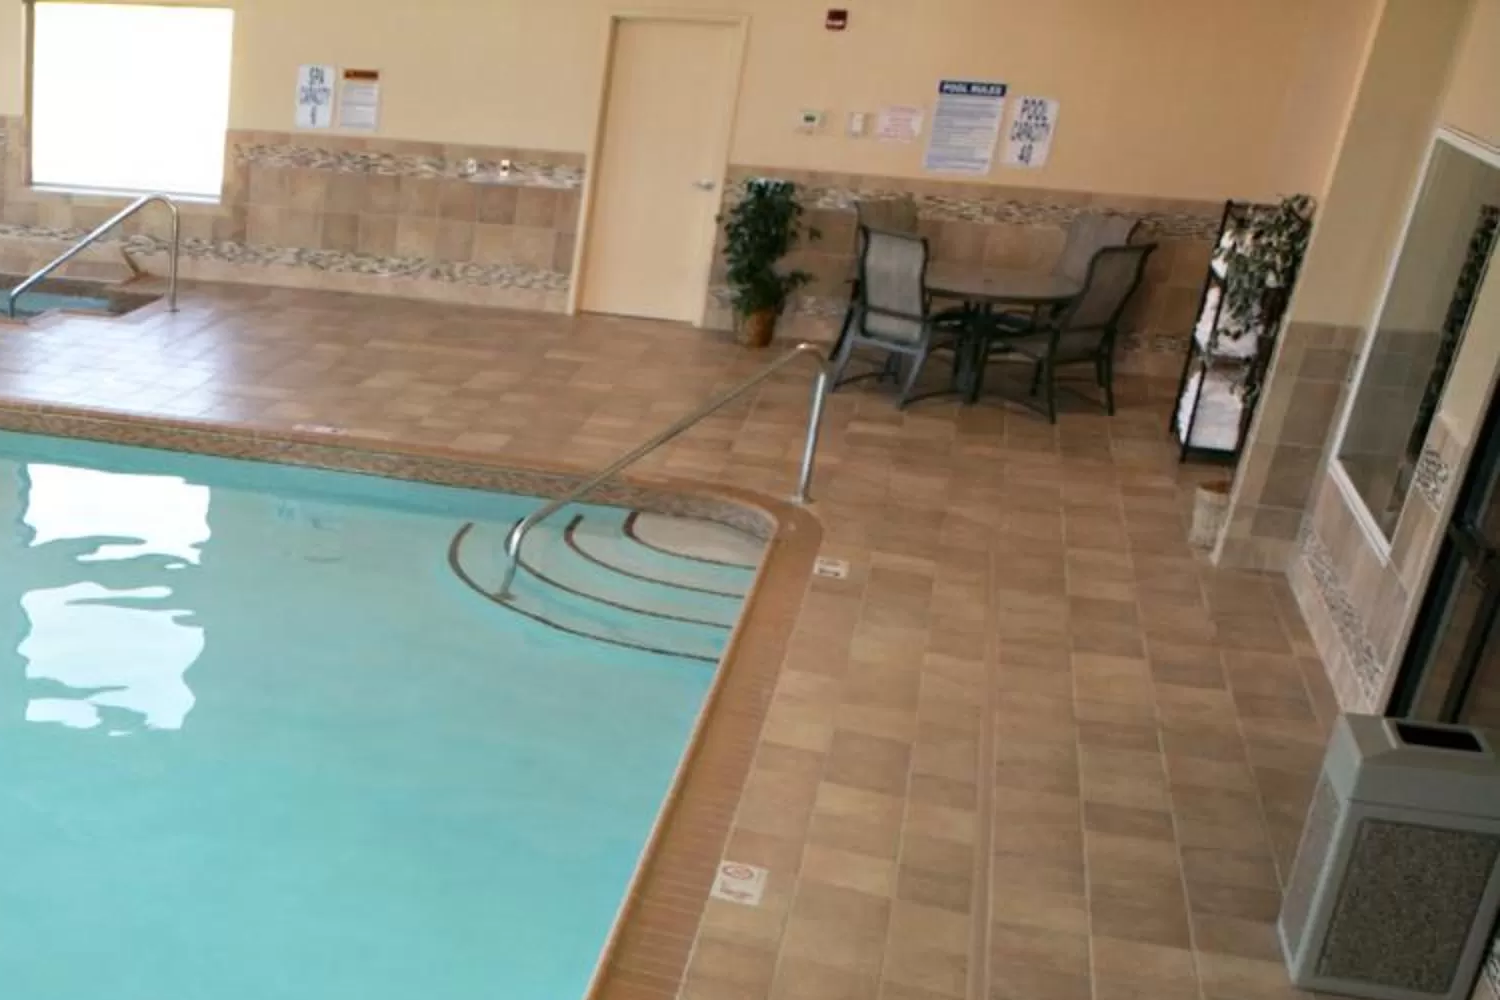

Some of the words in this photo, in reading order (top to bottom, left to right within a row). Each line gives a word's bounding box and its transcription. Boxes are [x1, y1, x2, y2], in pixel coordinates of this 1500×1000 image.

[943, 83, 967, 94] POOL
[971, 84, 1002, 95] RULES
[1022, 98, 1048, 120] POOL
